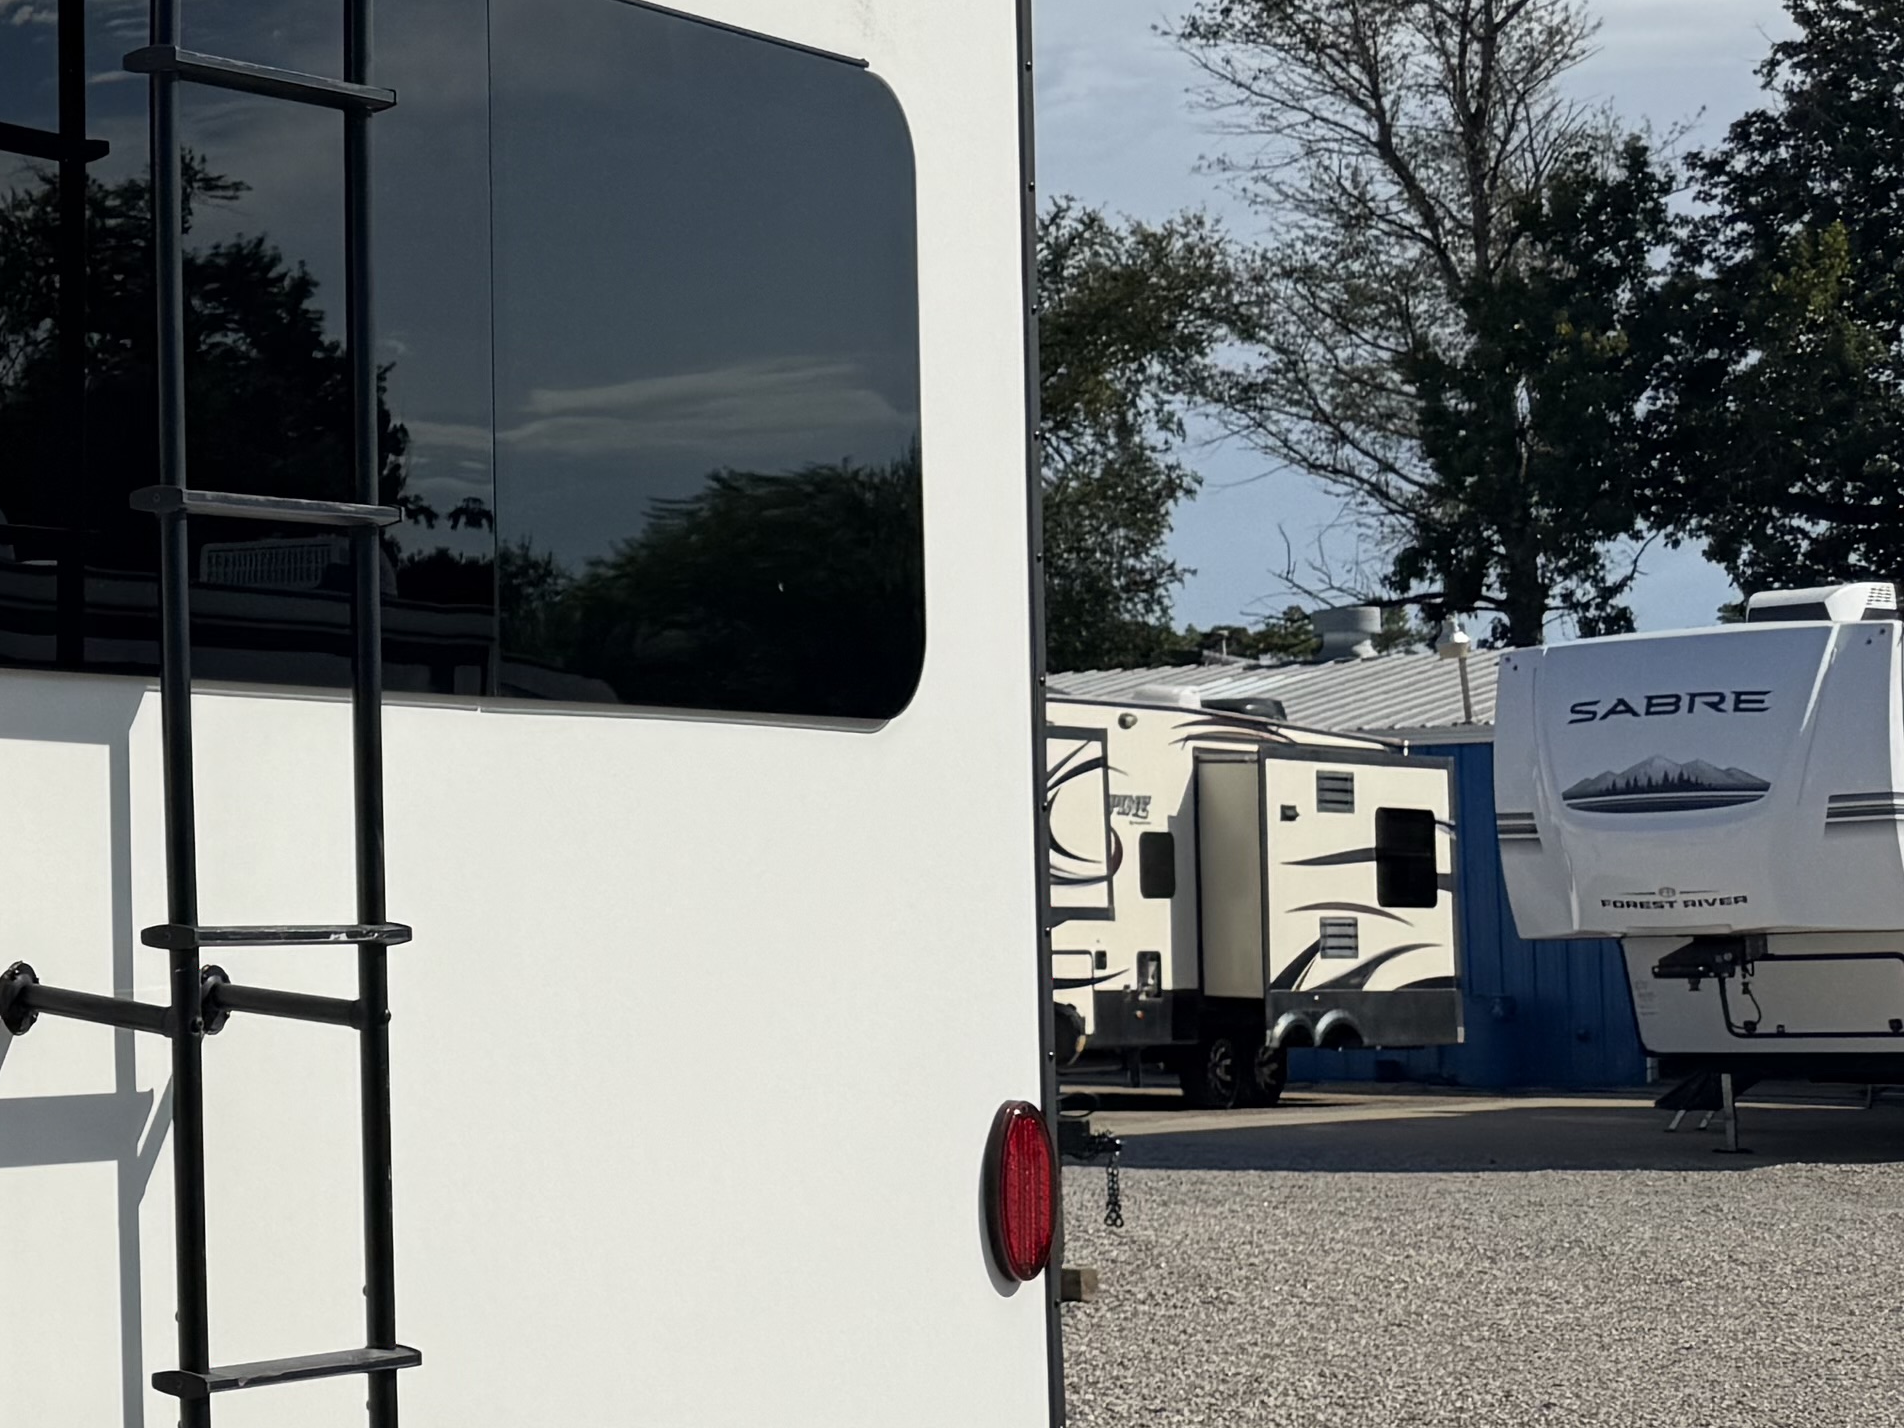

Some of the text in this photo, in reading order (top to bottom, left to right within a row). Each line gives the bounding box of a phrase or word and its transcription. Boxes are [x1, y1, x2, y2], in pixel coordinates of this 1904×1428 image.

[1567, 690, 1774, 724] SABRE
[1600, 895, 1748, 910] FOREST RIVER
